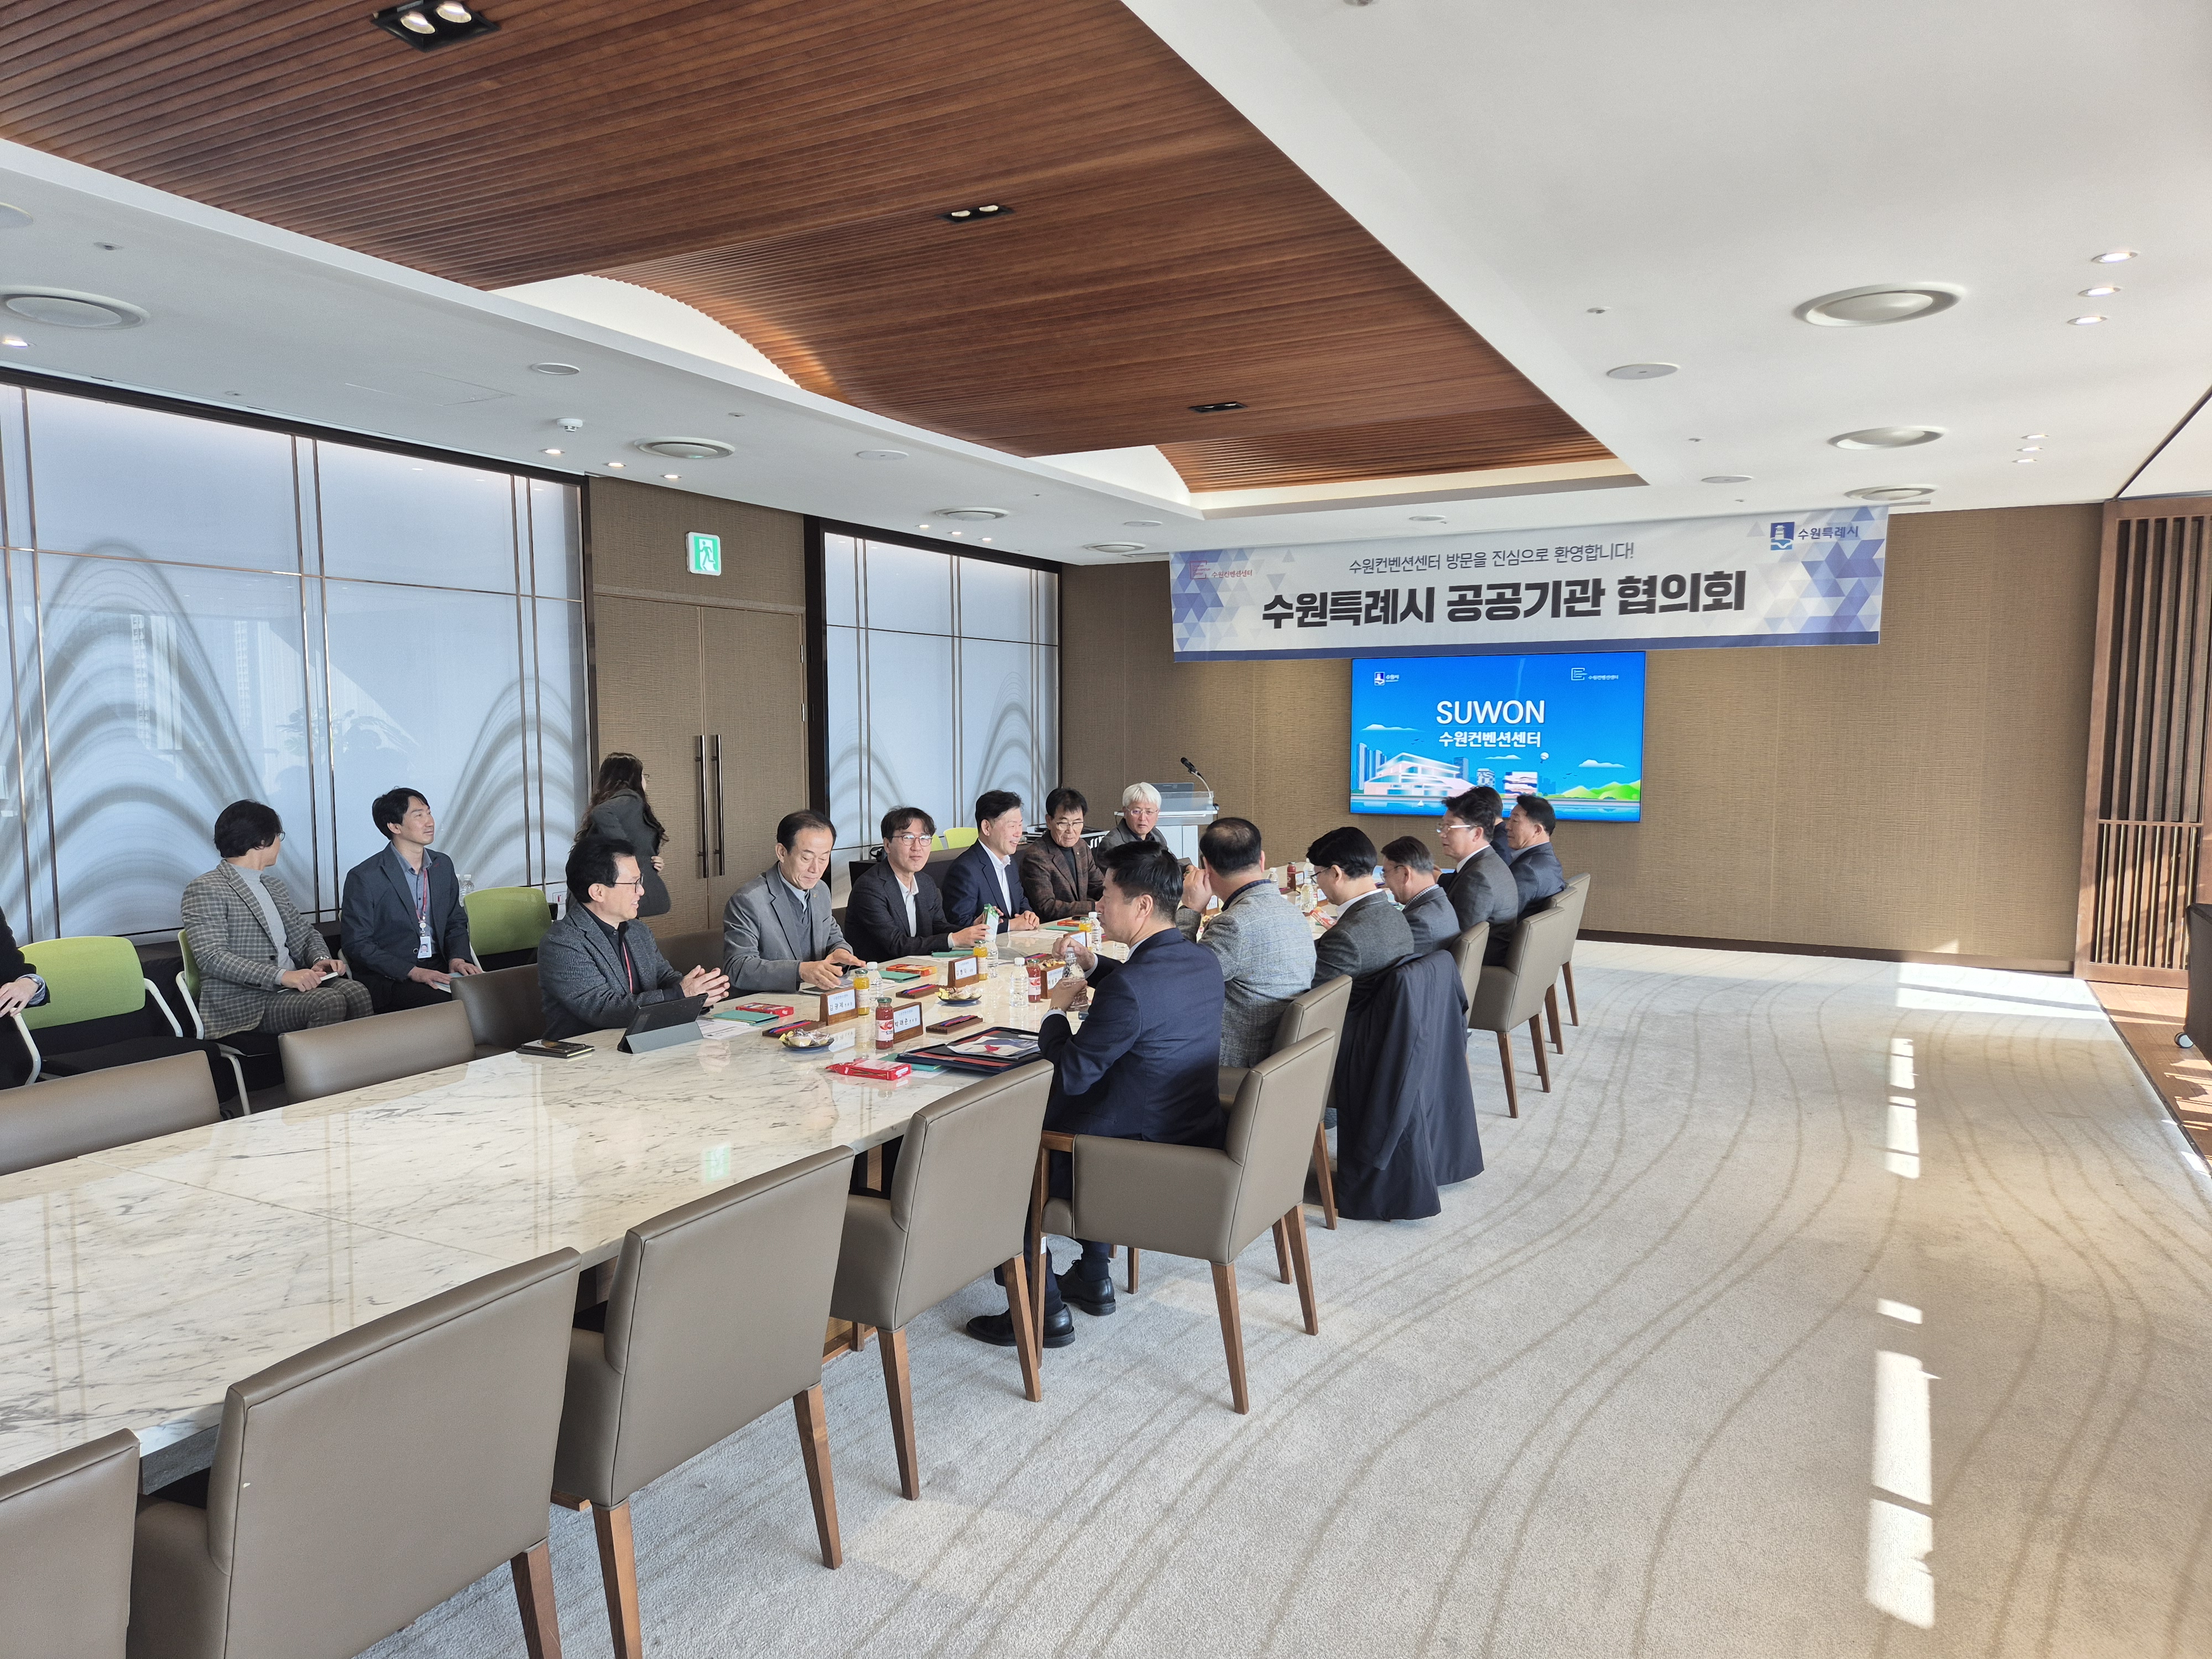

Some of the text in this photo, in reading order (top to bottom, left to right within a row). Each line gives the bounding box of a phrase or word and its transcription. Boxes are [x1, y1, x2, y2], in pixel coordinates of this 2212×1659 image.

[1797, 525, 1859, 540] 수원특례시
[1349, 541, 1634, 574] 수원컨벤션센터 방문을 진심으로 환영합니다!
[1212, 569, 1253, 578] 수원컨벤션센터
[1262, 570, 1747, 629] 수원특례시 공공기관 협의회
[1436, 700, 1545, 725] SUWON
[1438, 731, 1541, 748] 수원컨벤션센터
